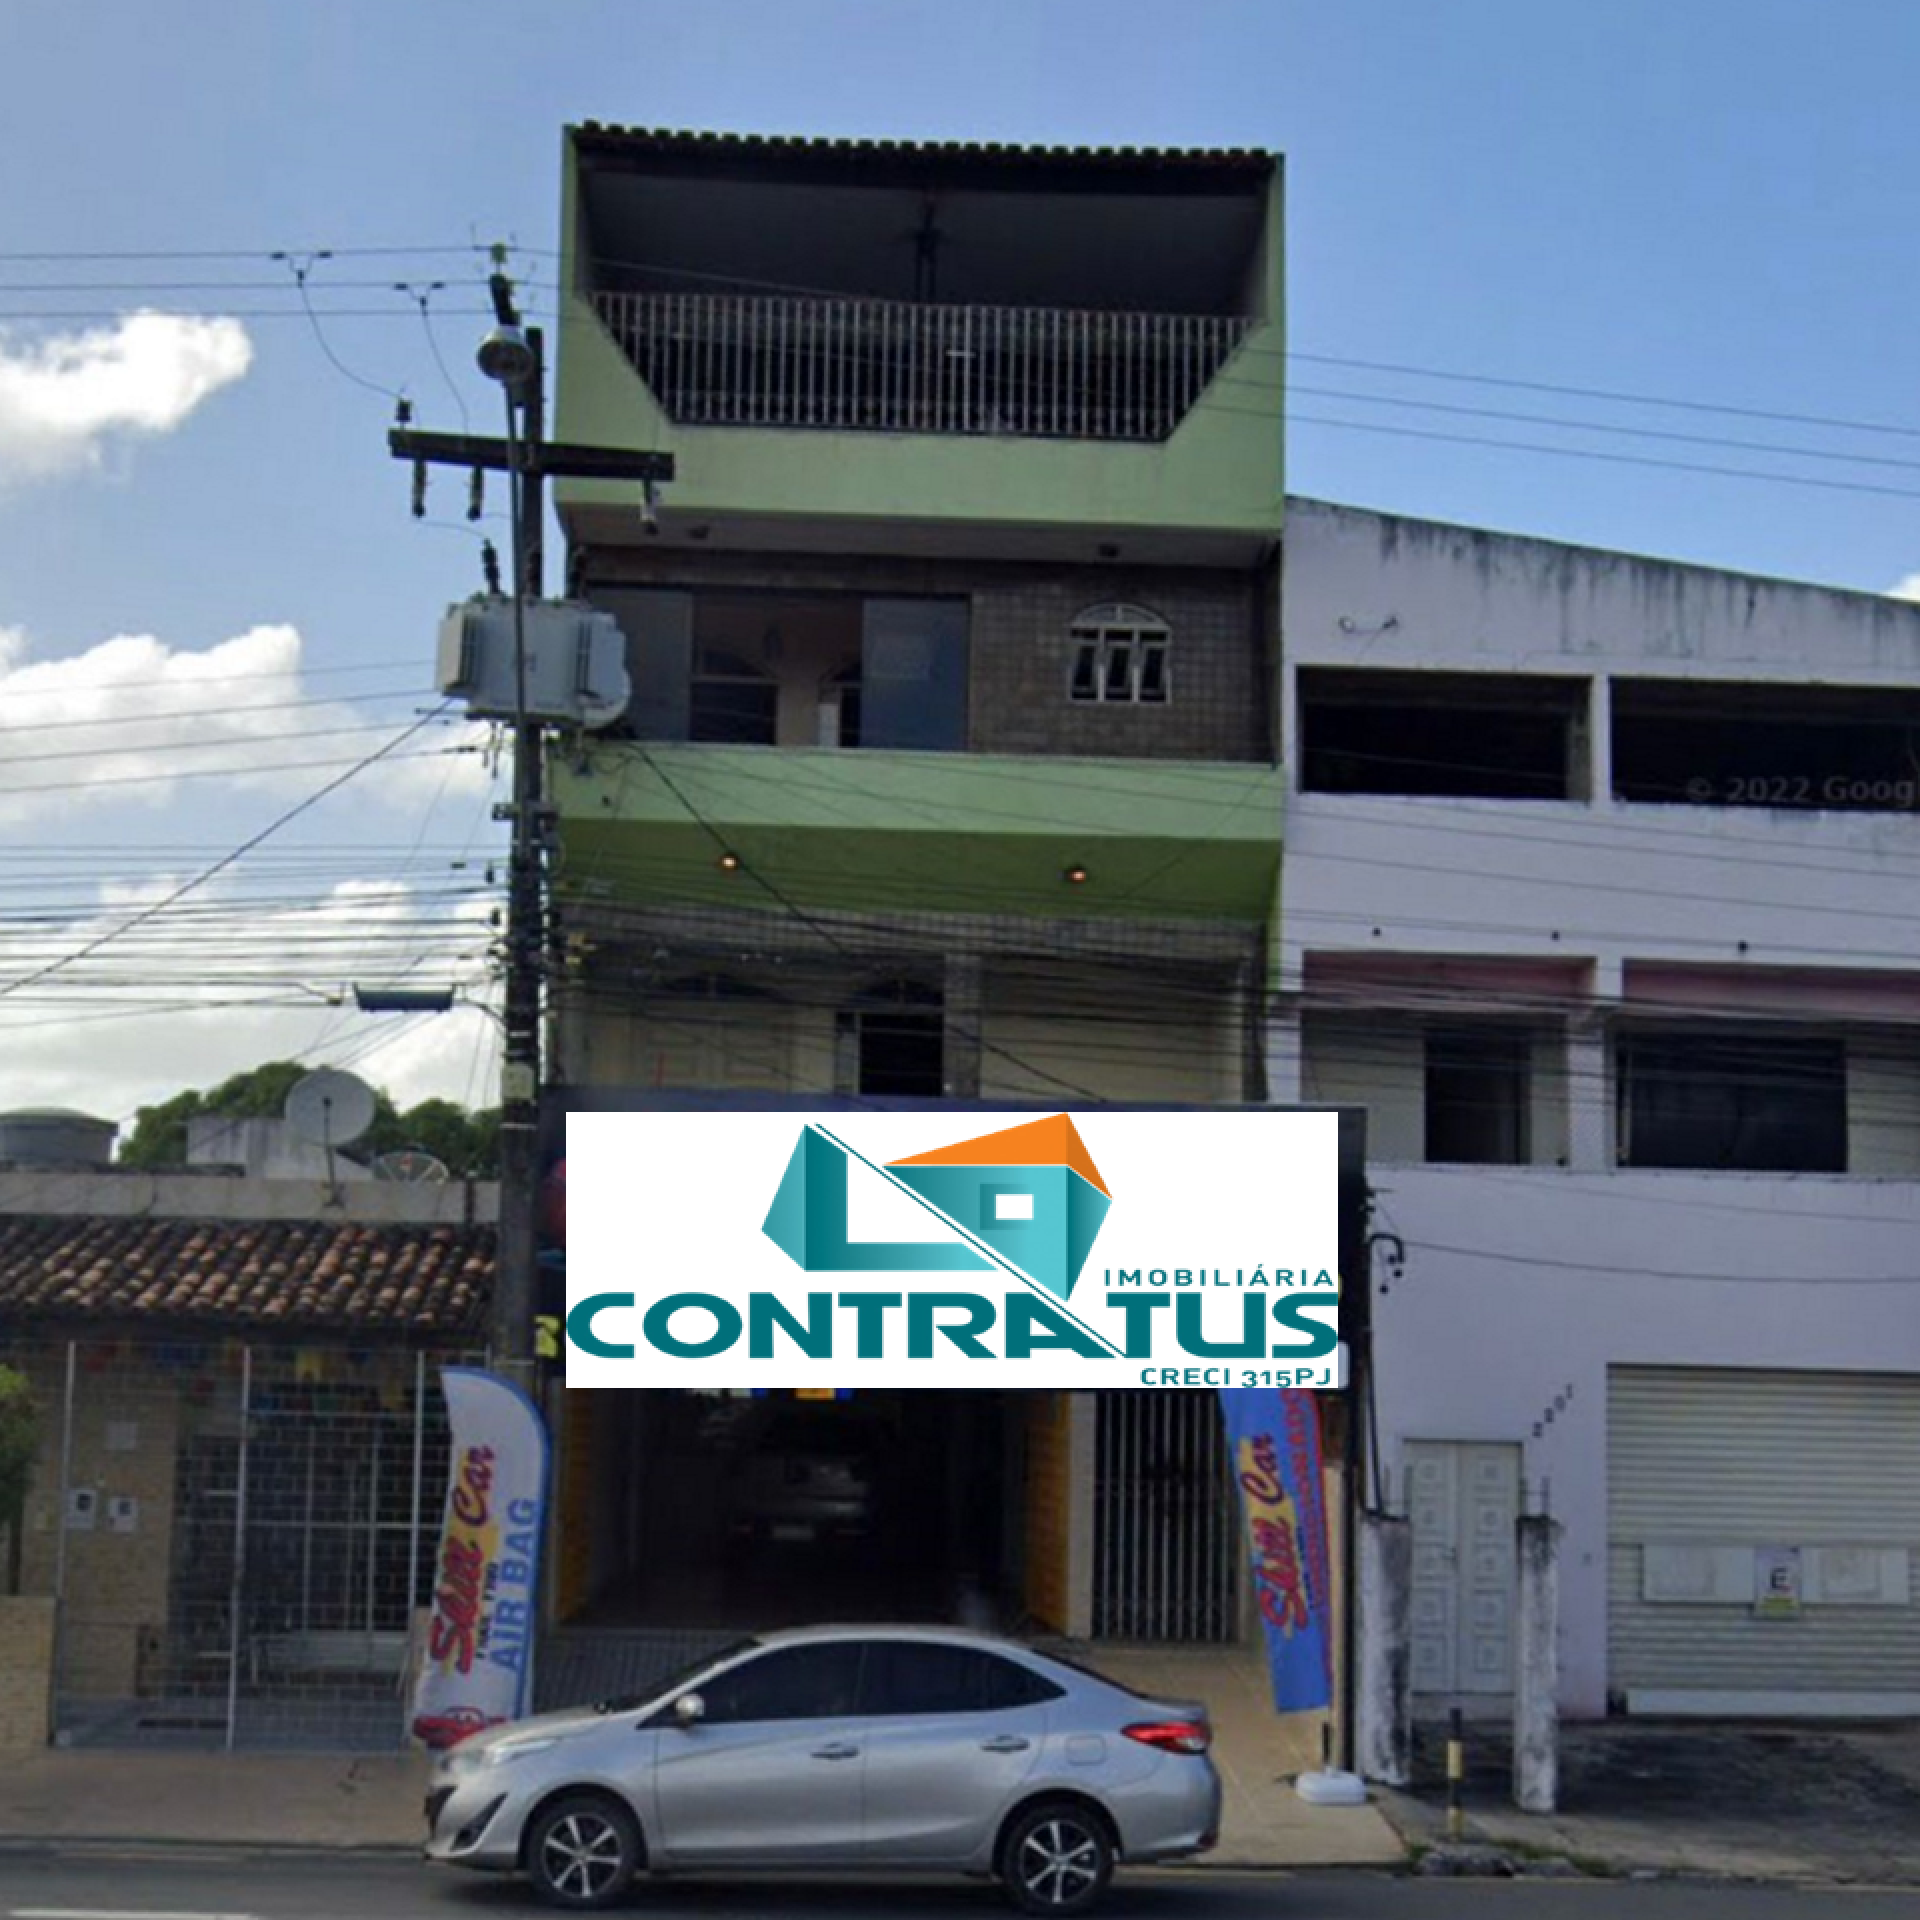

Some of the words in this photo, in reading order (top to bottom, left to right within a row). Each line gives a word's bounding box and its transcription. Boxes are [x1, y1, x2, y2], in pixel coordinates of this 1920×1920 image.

[452, 1445, 495, 1526] Car
[1241, 1432, 1284, 1504] Car
[502, 1499, 536, 1584] BAG
[489, 1600, 527, 1672] AIR
